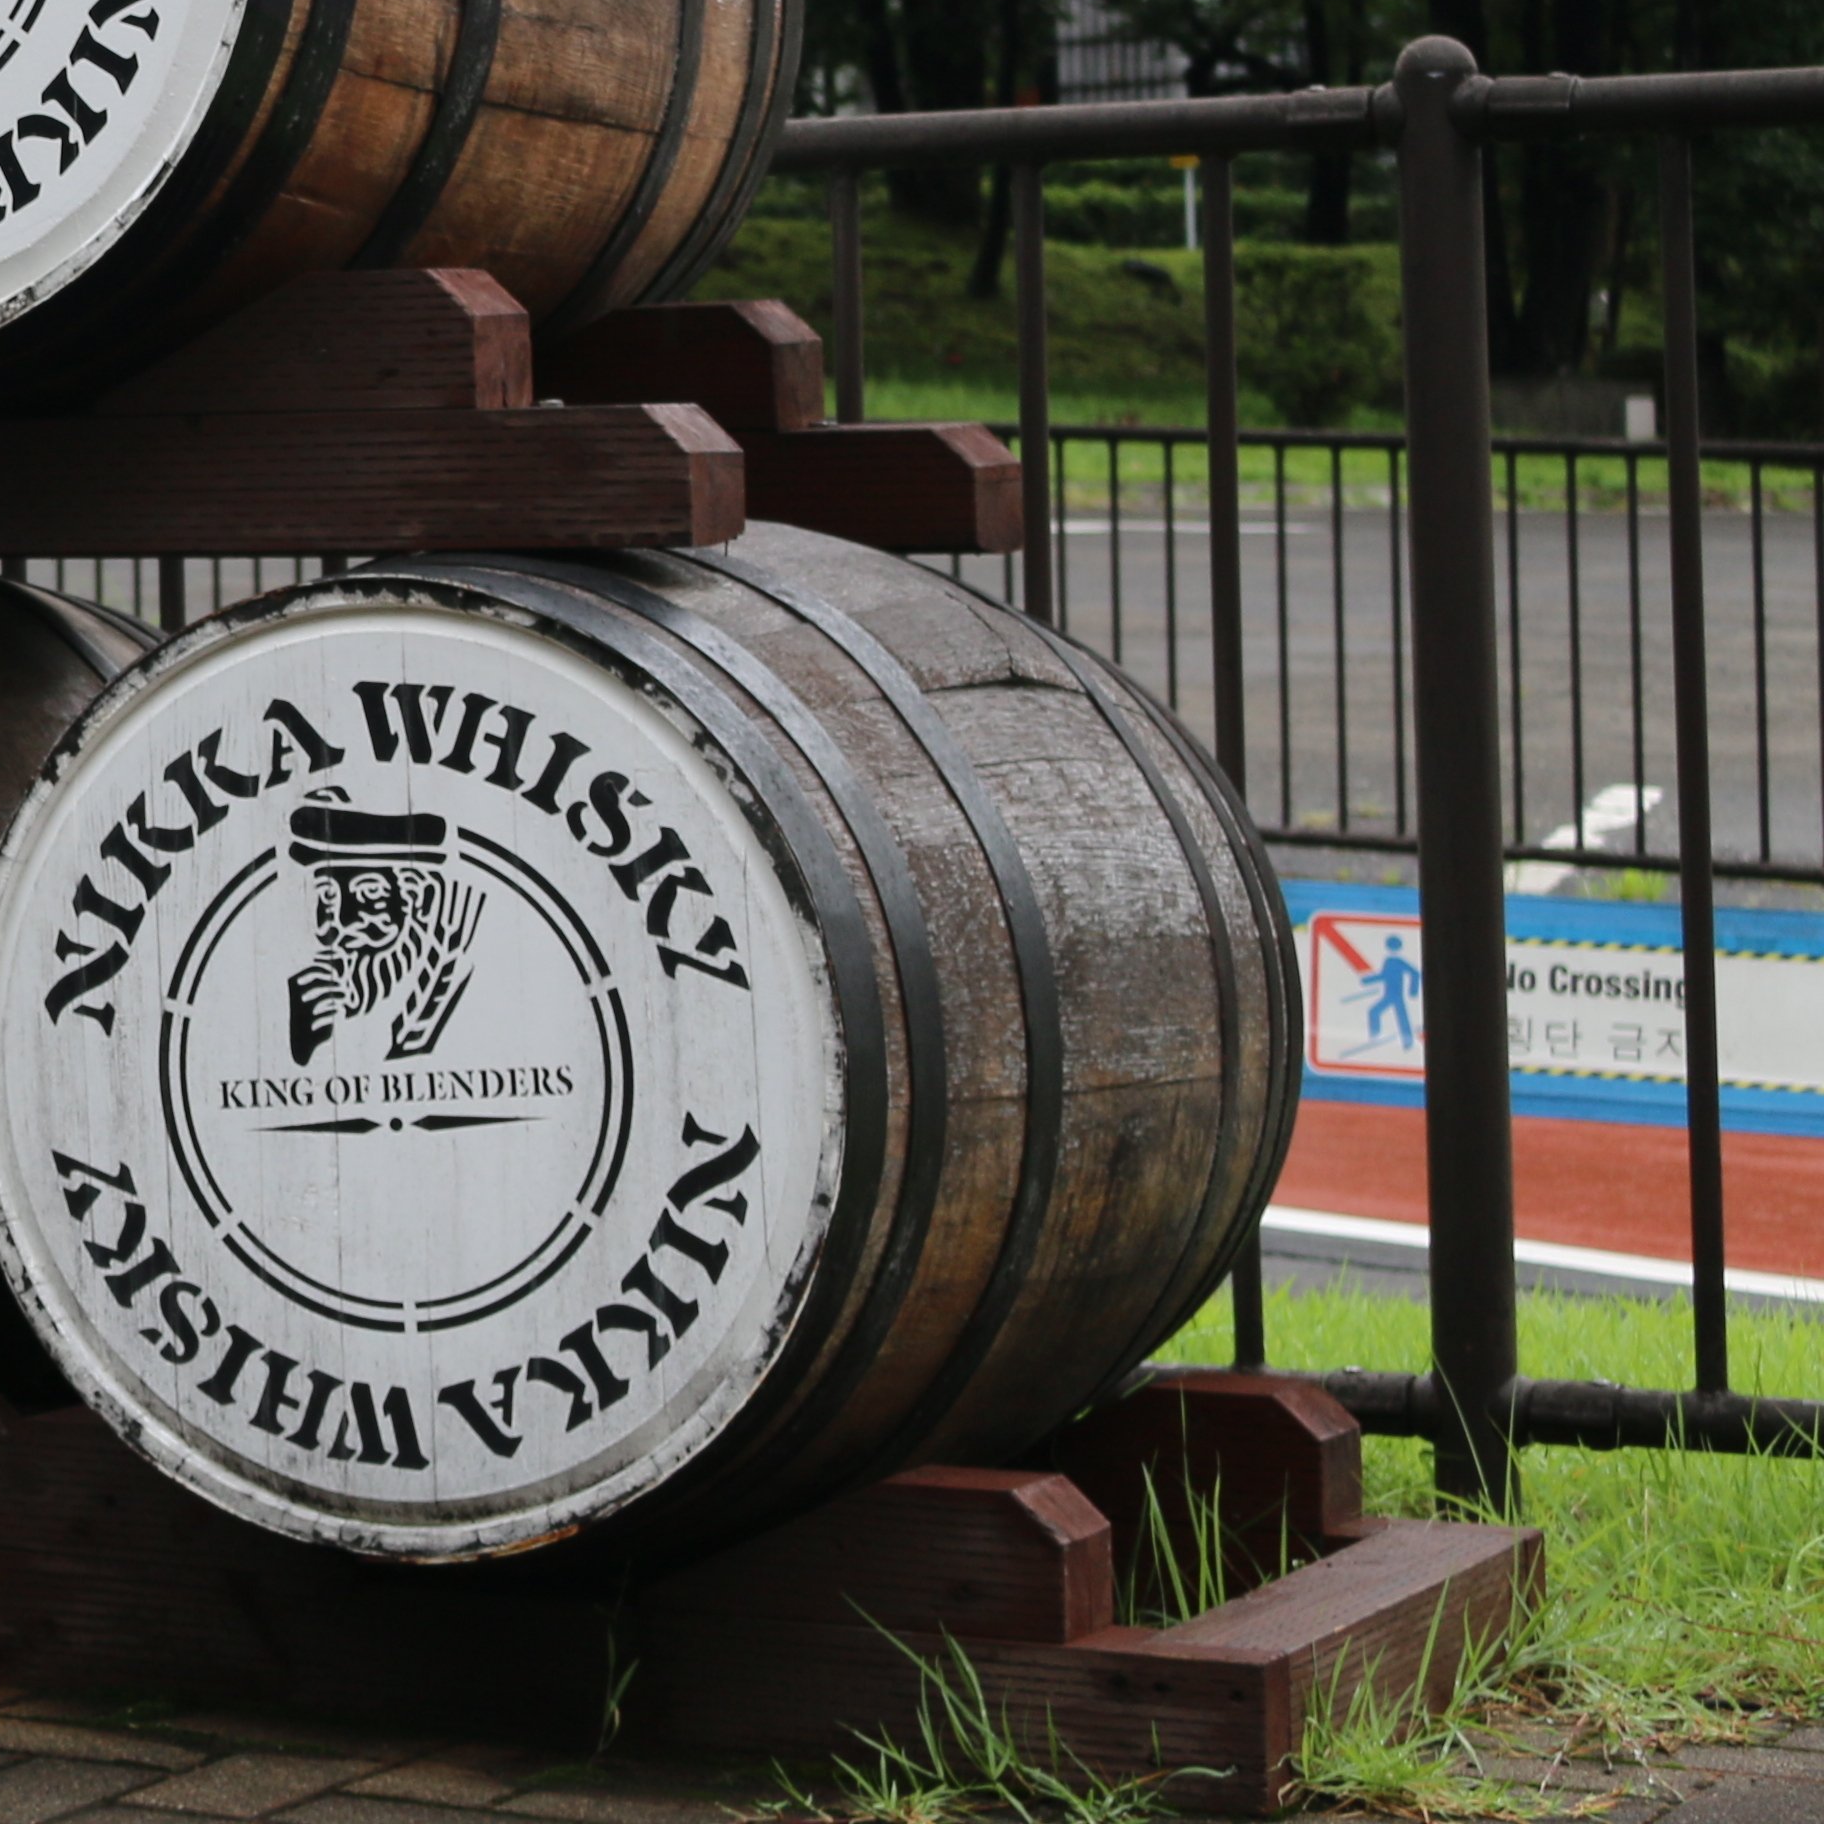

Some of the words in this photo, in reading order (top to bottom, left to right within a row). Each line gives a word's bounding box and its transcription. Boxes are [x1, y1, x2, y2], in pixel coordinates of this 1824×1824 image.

[45, 698, 345, 1036] NIKKA
[353, 681, 750, 992] WHISKY
[219, 1077, 314, 1110] KING
[324, 1076, 372, 1105] OF
[381, 1065, 573, 1103] BLENDERS
[52, 1148, 429, 1470] WHISKY
[439, 1112, 761, 1457] NIKKA
